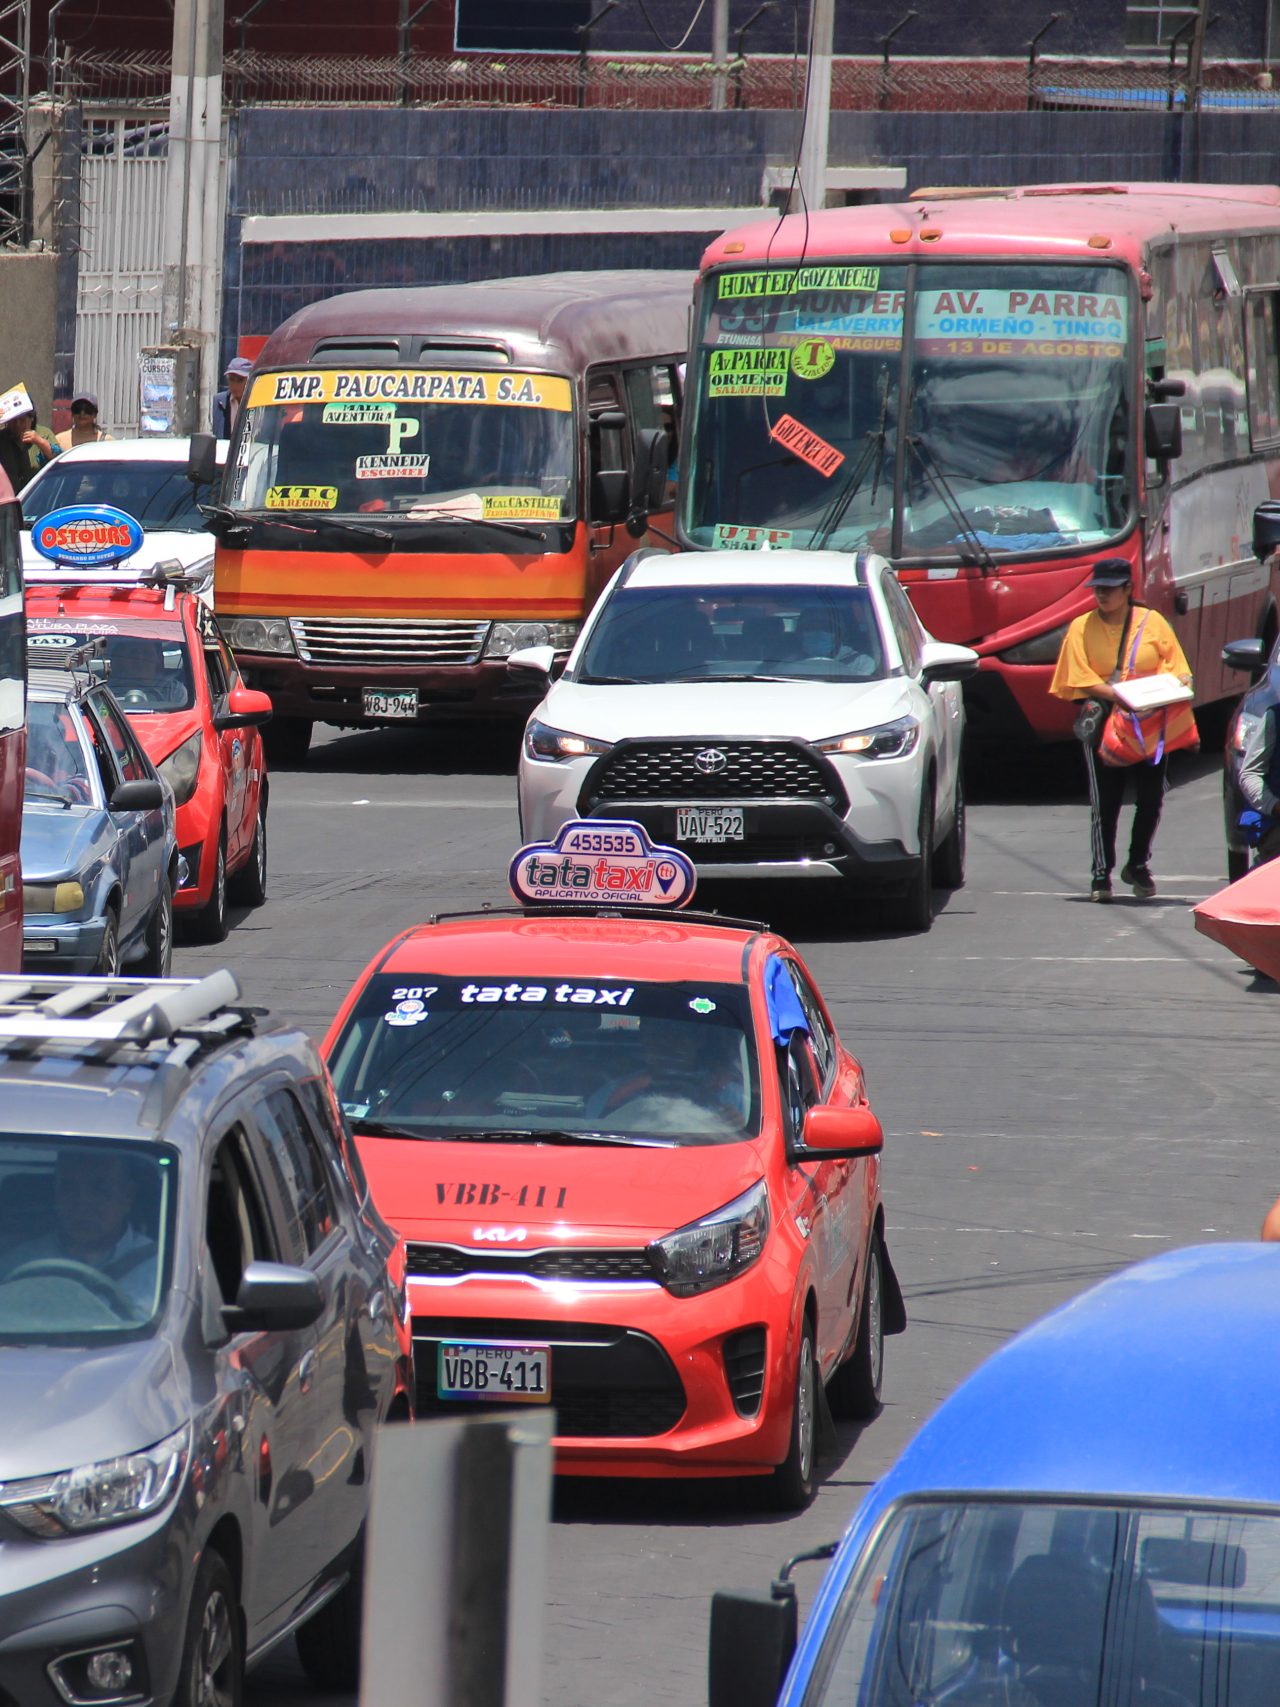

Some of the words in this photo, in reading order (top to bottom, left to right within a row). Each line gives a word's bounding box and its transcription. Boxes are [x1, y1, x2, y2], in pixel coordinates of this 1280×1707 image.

[721, 275, 796, 297] HUNTER
[800, 269, 877, 288] GOYENECHE
[788, 293, 904, 314] HUNTER
[933, 292, 984, 315] AV.
[1008, 292, 1122, 320] PARRA
[793, 317, 901, 333] SALAVERRY
[938, 315, 1035, 334] ORMEÑO
[1053, 319, 1122, 337] TINGO
[804, 342, 825, 366] T
[946, 341, 974, 354] 13
[981, 342, 1013, 354] DE
[1022, 342, 1121, 357] AGOSTO
[143, 365, 169, 373] CURSOS
[731, 350, 787, 371] PARRA
[274, 375, 324, 400] EMP.
[334, 375, 487, 400] PAUCARPATA
[497, 378, 542, 402] S.A.
[325, 411, 392, 422] AVENTURA
[386, 418, 419, 454] P
[359, 456, 428, 469] KENNEDY
[361, 468, 426, 477] ESCOMEL
[271, 499, 285, 507] LA
[287, 499, 330, 507] REGION
[508, 497, 559, 509] CASTILLA
[40, 524, 133, 549] OSTOURS
[720, 525, 791, 543] UTP
[721, 540, 782, 550] SHAL
[679, 816, 743, 836] VAV-522
[570, 834, 636, 853] 453535
[526, 855, 592, 890] tata
[593, 858, 657, 892] taxi
[534, 888, 600, 899] APLICATIVO
[603, 890, 644, 902] OFICIAL
[392, 986, 439, 1000] 207
[460, 983, 545, 1004] tata
[555, 983, 635, 1006] taxi
[434, 1182, 568, 1209] VBB-411
[475, 1348, 514, 1360] PERU
[445, 1357, 545, 1392] VBB-411
